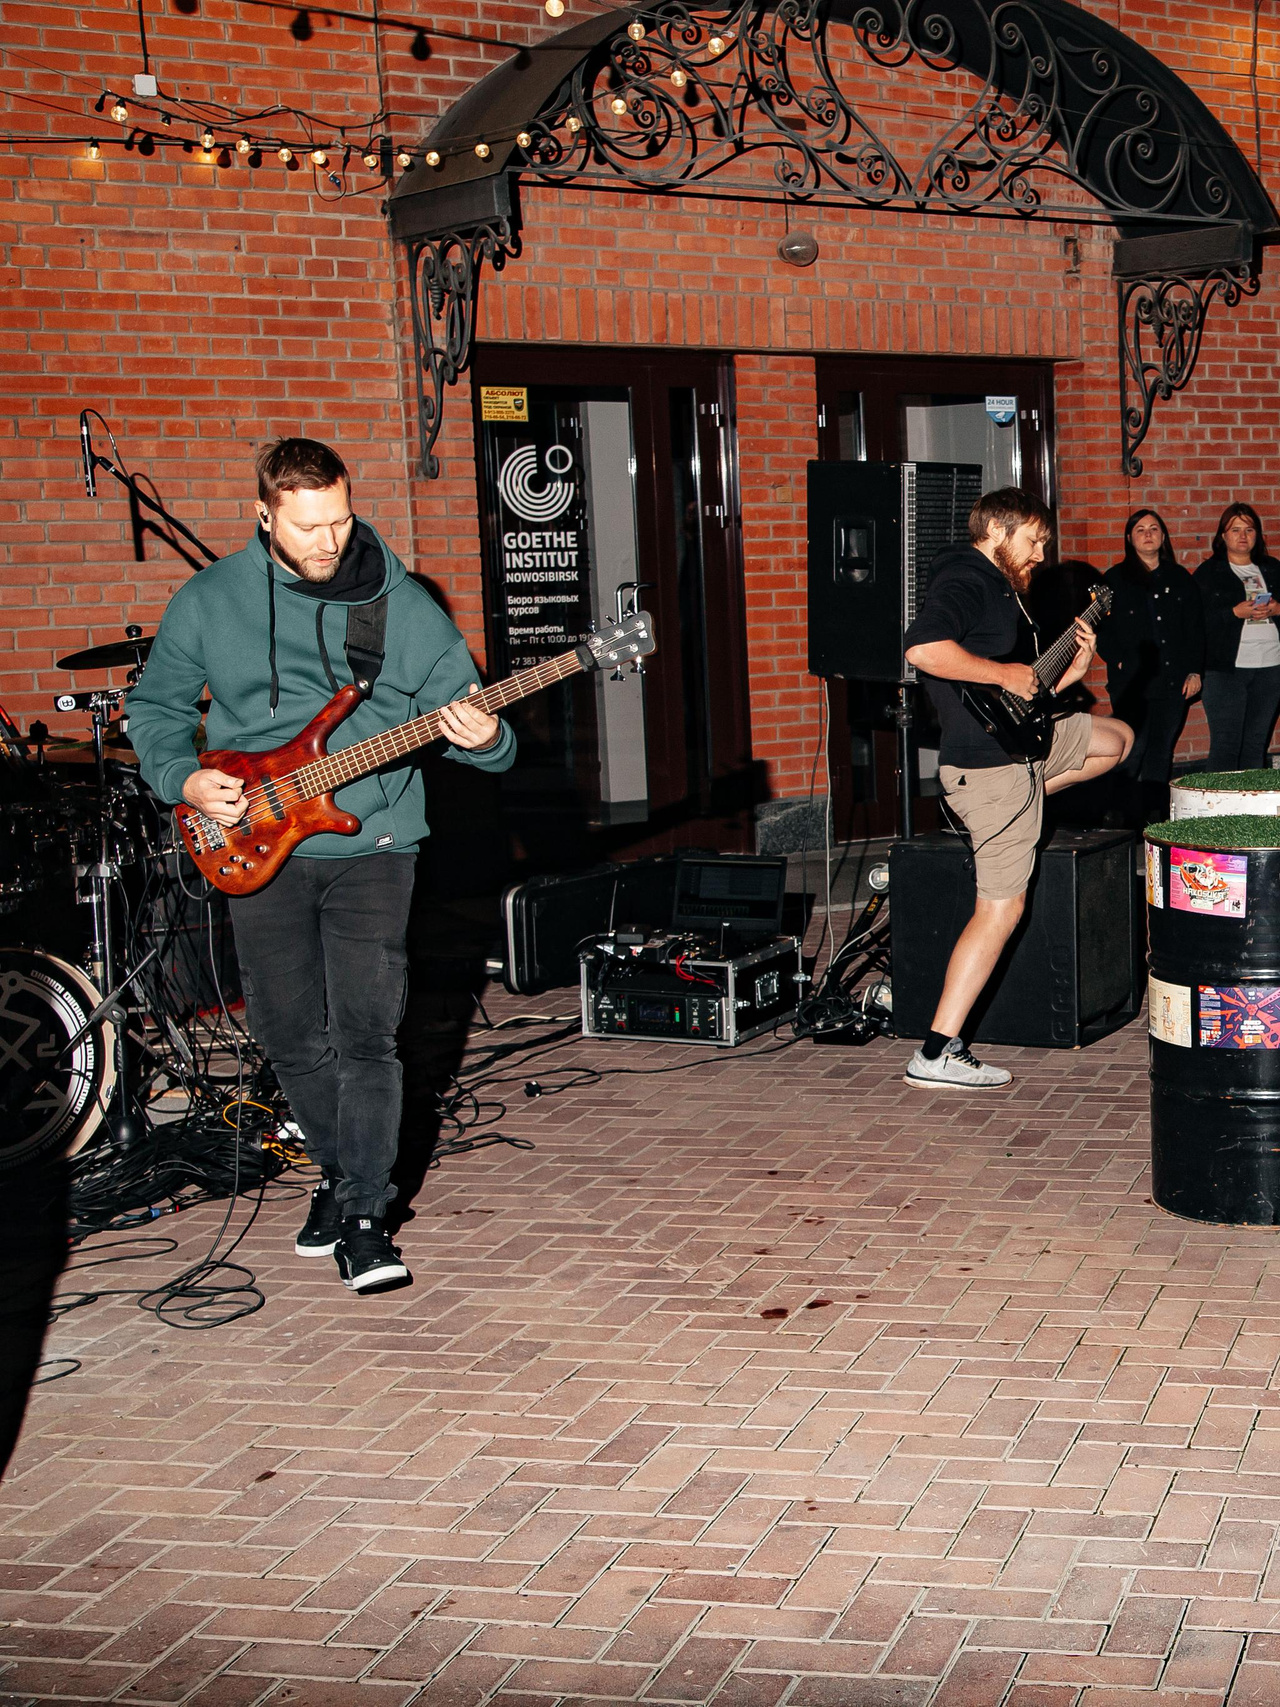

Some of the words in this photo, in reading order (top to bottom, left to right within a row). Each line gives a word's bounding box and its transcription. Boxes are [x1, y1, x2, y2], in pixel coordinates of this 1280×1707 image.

[504, 532, 578, 549] GOETHE
[505, 551, 578, 569] INSTITUT
[506, 571, 579, 583] NOWOSIBIRSK
[508, 596, 532, 606] Бюро
[534, 595, 579, 604] языковых
[508, 606, 540, 616] курсов
[508, 627, 534, 636] Время
[535, 625, 564, 634] работы
[547, 635, 566, 643] 10:00
[578, 634, 594, 642] 19:0
